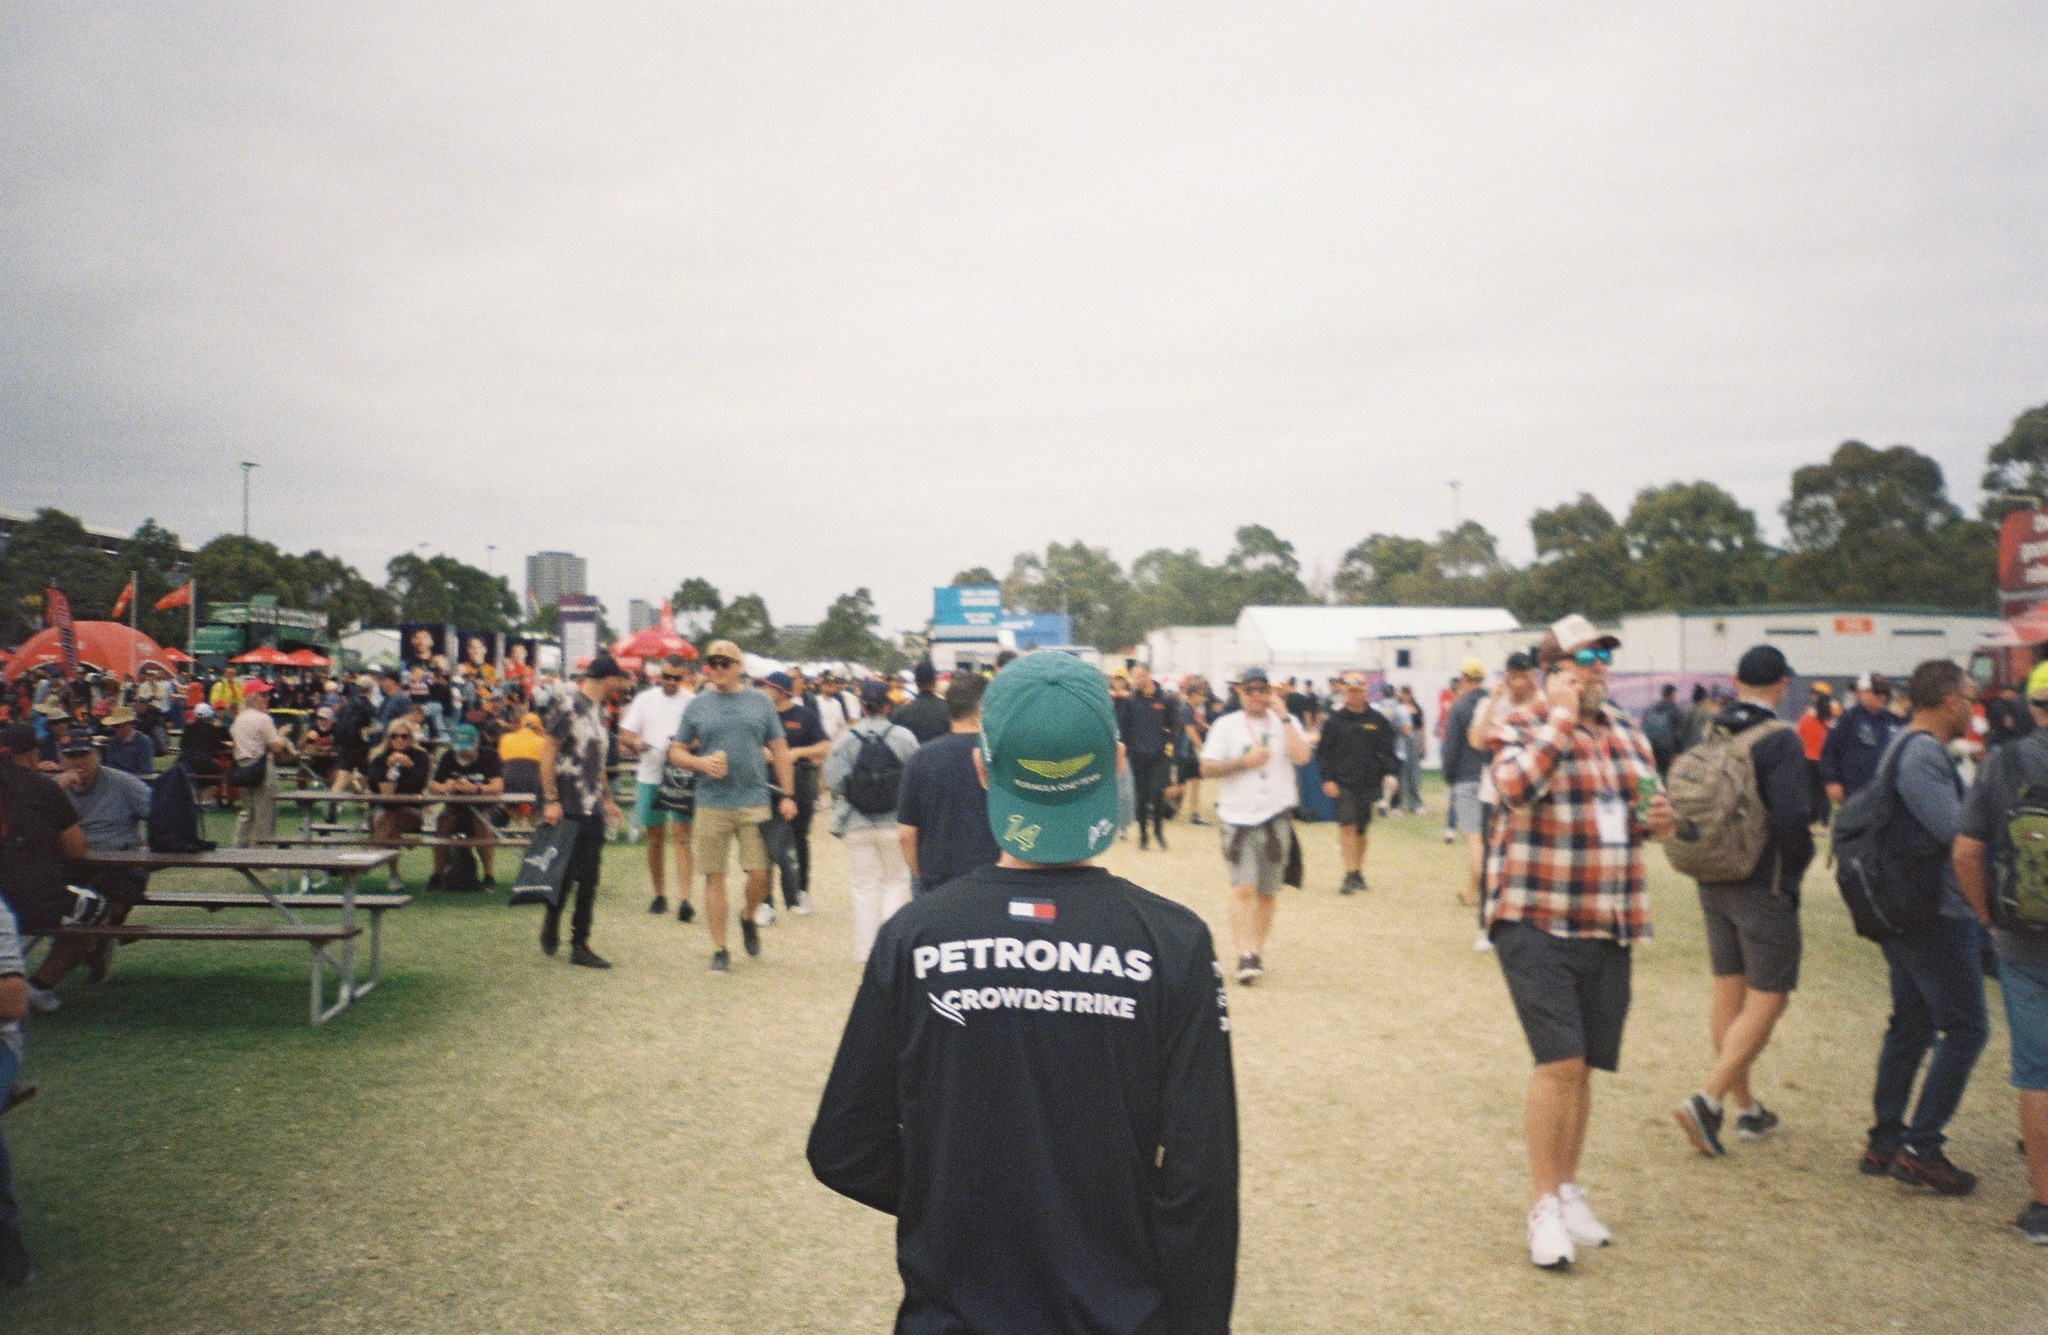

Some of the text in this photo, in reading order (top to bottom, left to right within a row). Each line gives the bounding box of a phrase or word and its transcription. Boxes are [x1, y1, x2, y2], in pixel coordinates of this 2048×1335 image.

[1004, 814, 1042, 851] 14
[913, 937, 1153, 982] PETRONAS
[941, 986, 1137, 1019] CROWDSTRIKE
